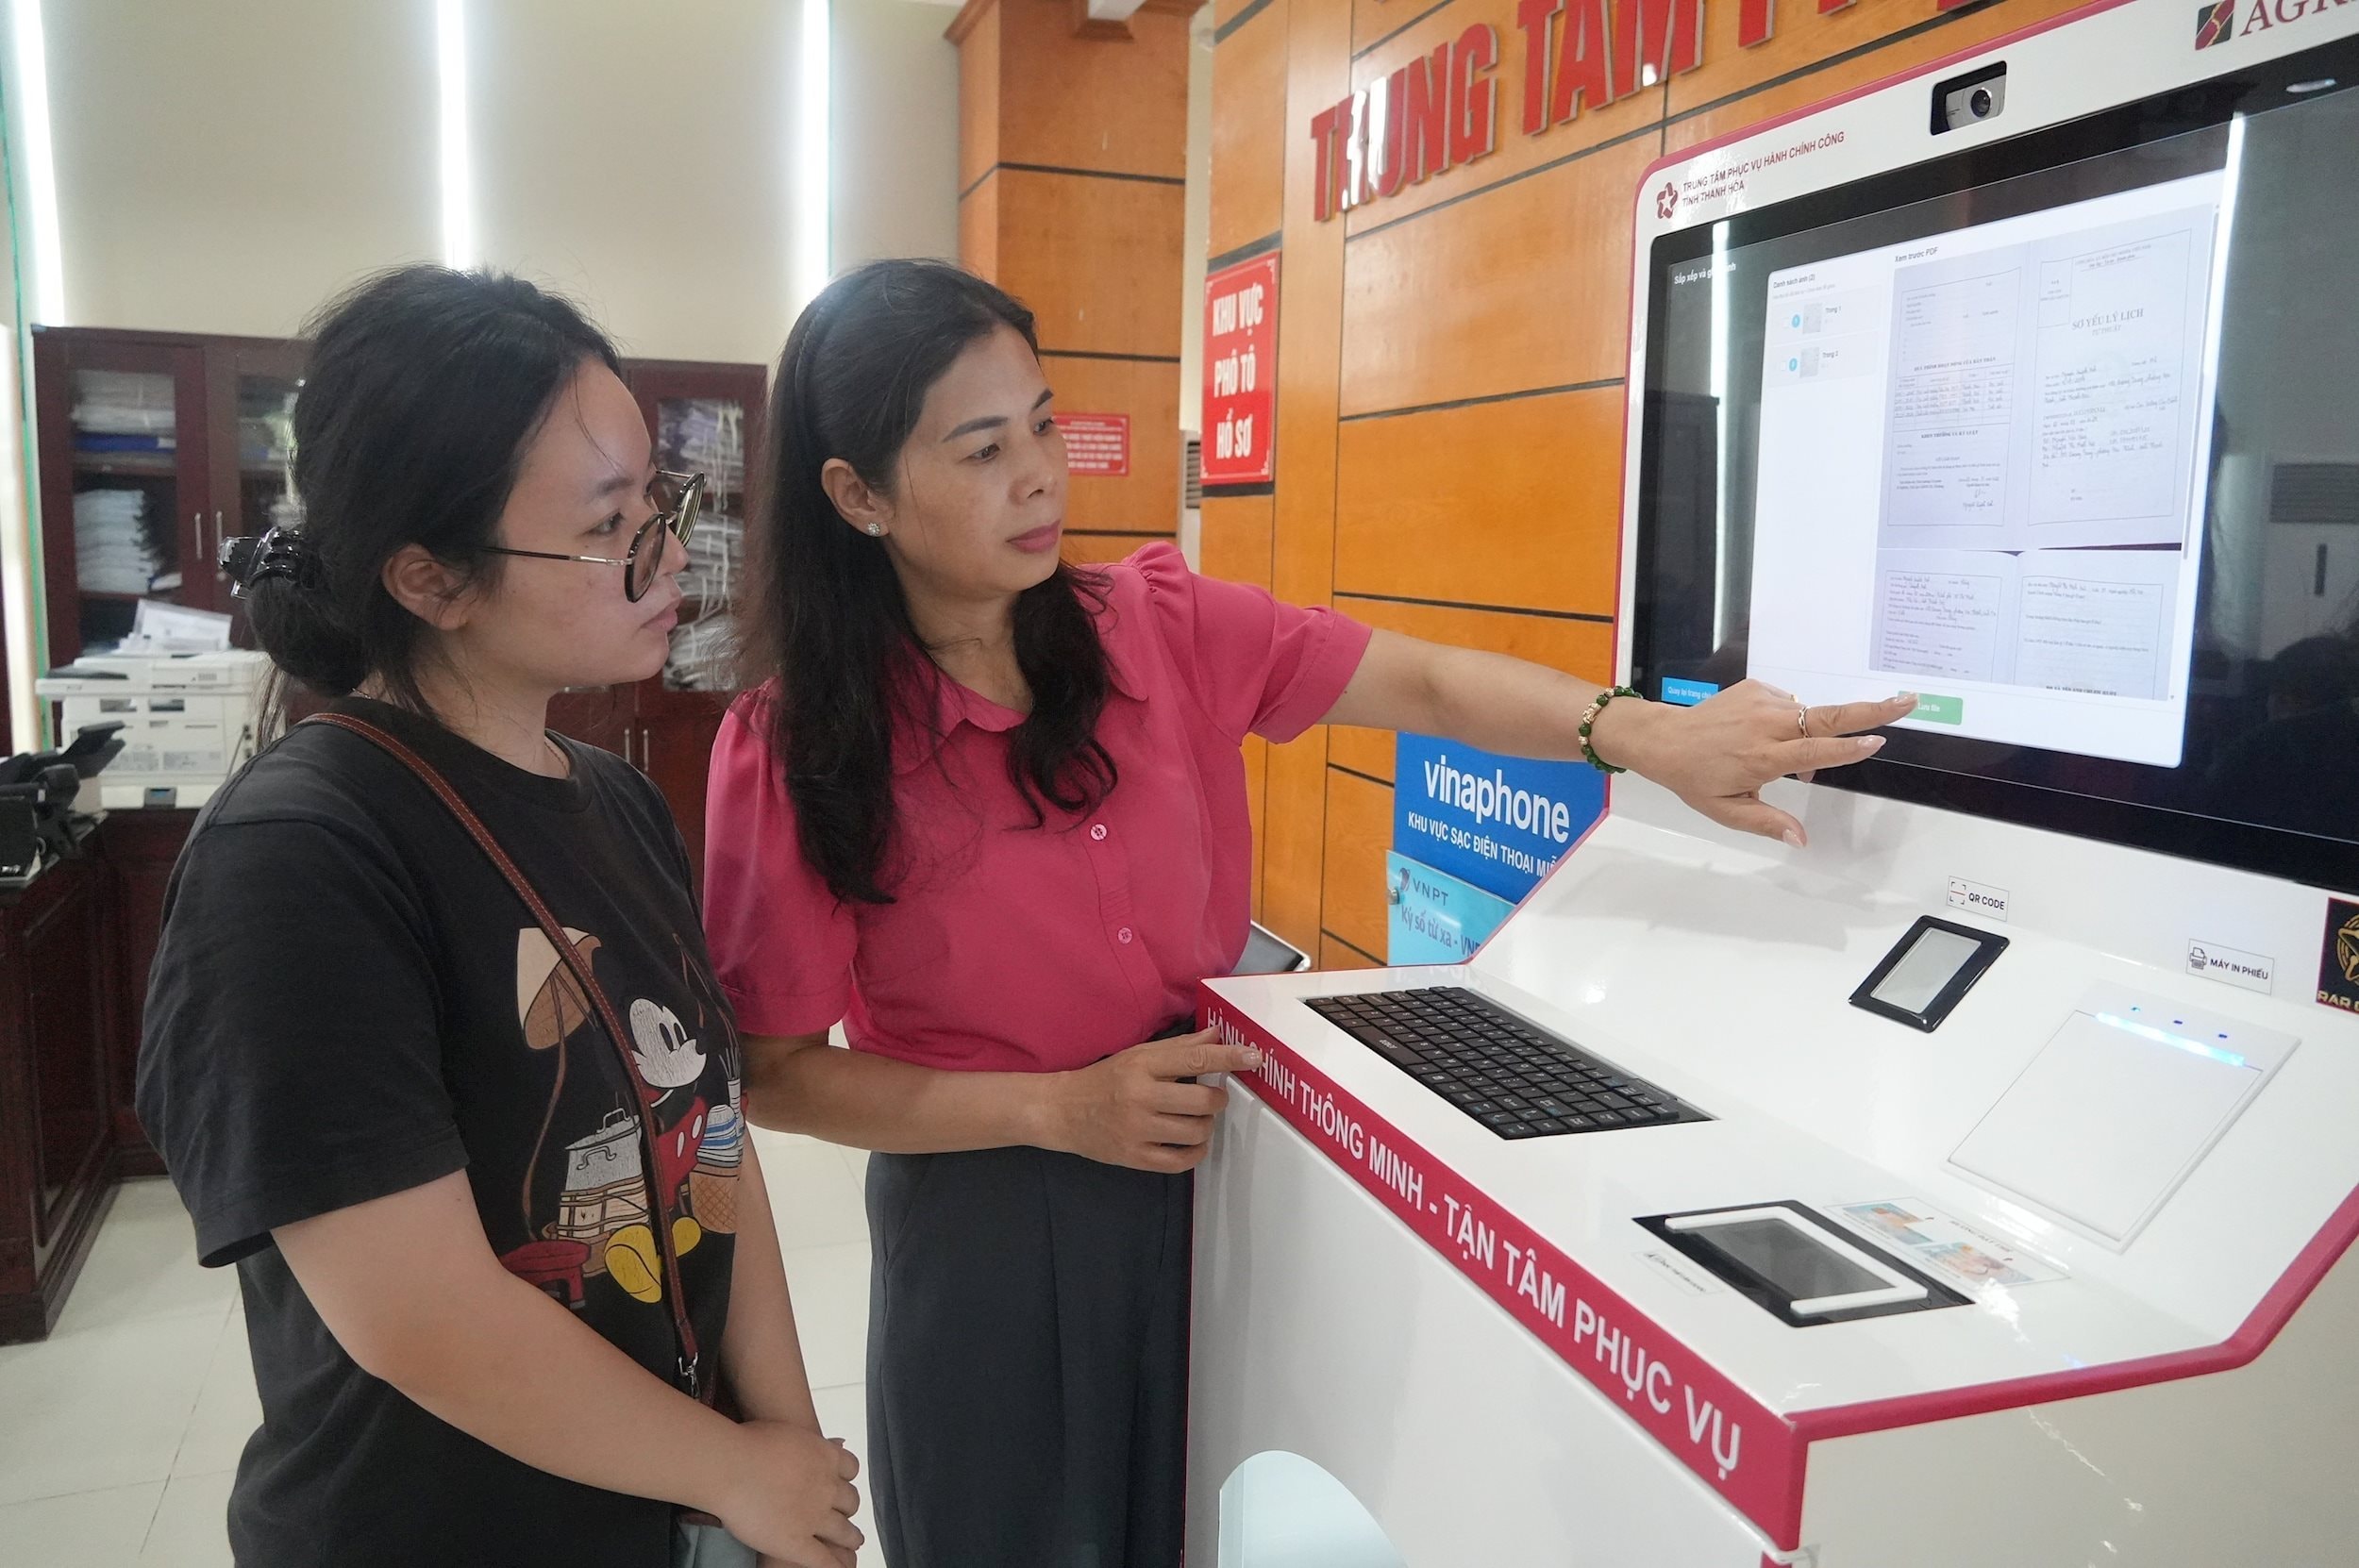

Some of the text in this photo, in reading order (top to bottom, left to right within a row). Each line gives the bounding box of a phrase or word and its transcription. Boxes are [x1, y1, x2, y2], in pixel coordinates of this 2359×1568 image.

[1311, 23, 1498, 222] TRUNG
[1683, 130, 1845, 192] TRUNG TÂM PHỤC VỤ HÀNH CHÍNH CÔNG
[1700, 185, 1726, 202] THANH
[1925, 246, 1938, 257] PDF
[1213, 282, 1264, 337] KHU VỰC
[1213, 343, 1256, 398] PHÔ TÔ
[1234, 413, 1253, 459] SƠ
[1424, 754, 1570, 843] vinaphone
[1408, 810, 1428, 833] KHU
[1429, 818, 1448, 842] VỰC
[1450, 826, 1471, 850] SẠC
[1473, 834, 1498, 860] ĐIỆN
[1500, 844, 1533, 875] THOẠI
[1413, 878, 1449, 906] VNPT
[1968, 892, 2006, 911] QR CODE
[1414, 909, 1426, 933] số
[1428, 918, 1438, 940] từ
[1440, 927, 1452, 948] xa
[2210, 957, 2268, 980] MÁY IN PHIẾU
[1249, 1041, 1296, 1106] HÍNH
[1300, 1079, 1364, 1160] THÔNG
[1369, 1135, 1424, 1211] MINH
[1429, 1202, 1438, 1214] -
[1444, 1193, 1496, 1271] TẬN
[1502, 1240, 1566, 1329] TÂM
[1573, 1298, 1673, 1415] PHỤC
[1683, 1383, 1742, 1481] VỤ
